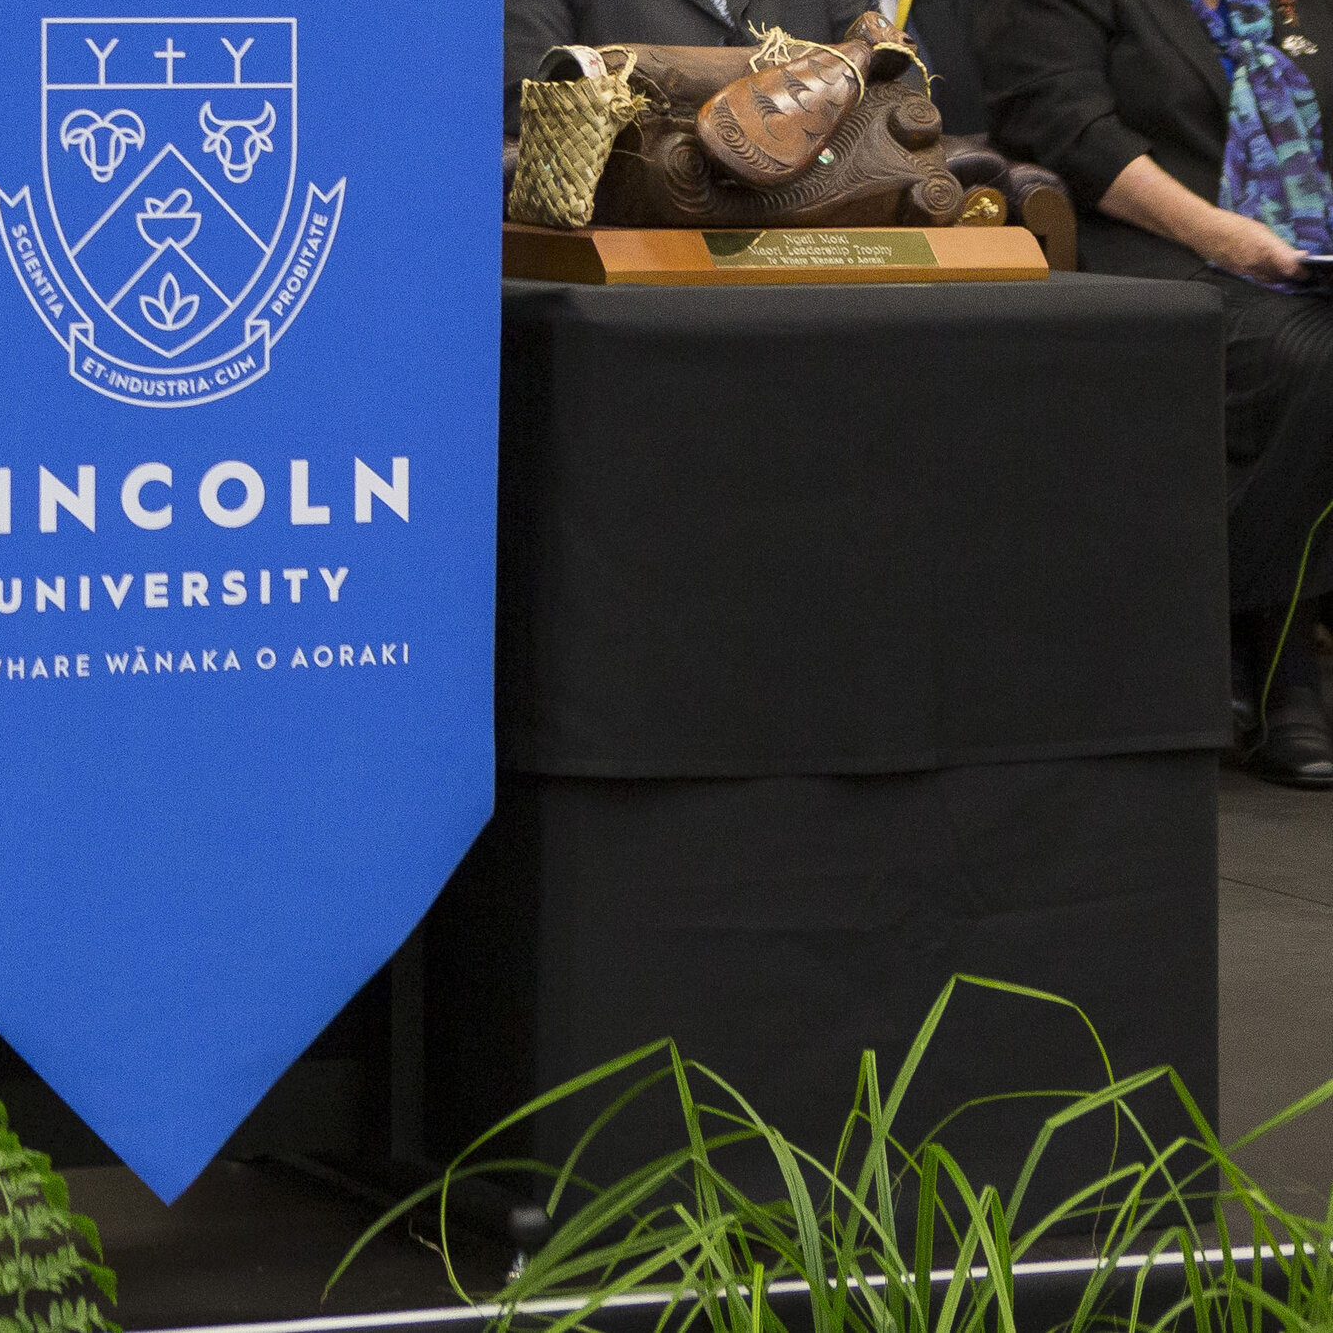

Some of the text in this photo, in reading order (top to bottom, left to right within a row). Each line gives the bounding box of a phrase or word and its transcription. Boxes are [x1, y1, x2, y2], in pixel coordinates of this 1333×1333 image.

[11, 224, 65, 319] SCIENTIA
[271, 213, 329, 317] PROBITATE
[785, 244, 850, 257] Leadership
[853, 244, 893, 257] Trophy
[105, 645, 241, 674] WĀNAKA
[255, 646, 277, 670] O
[290, 642, 409, 669] AORAKI
